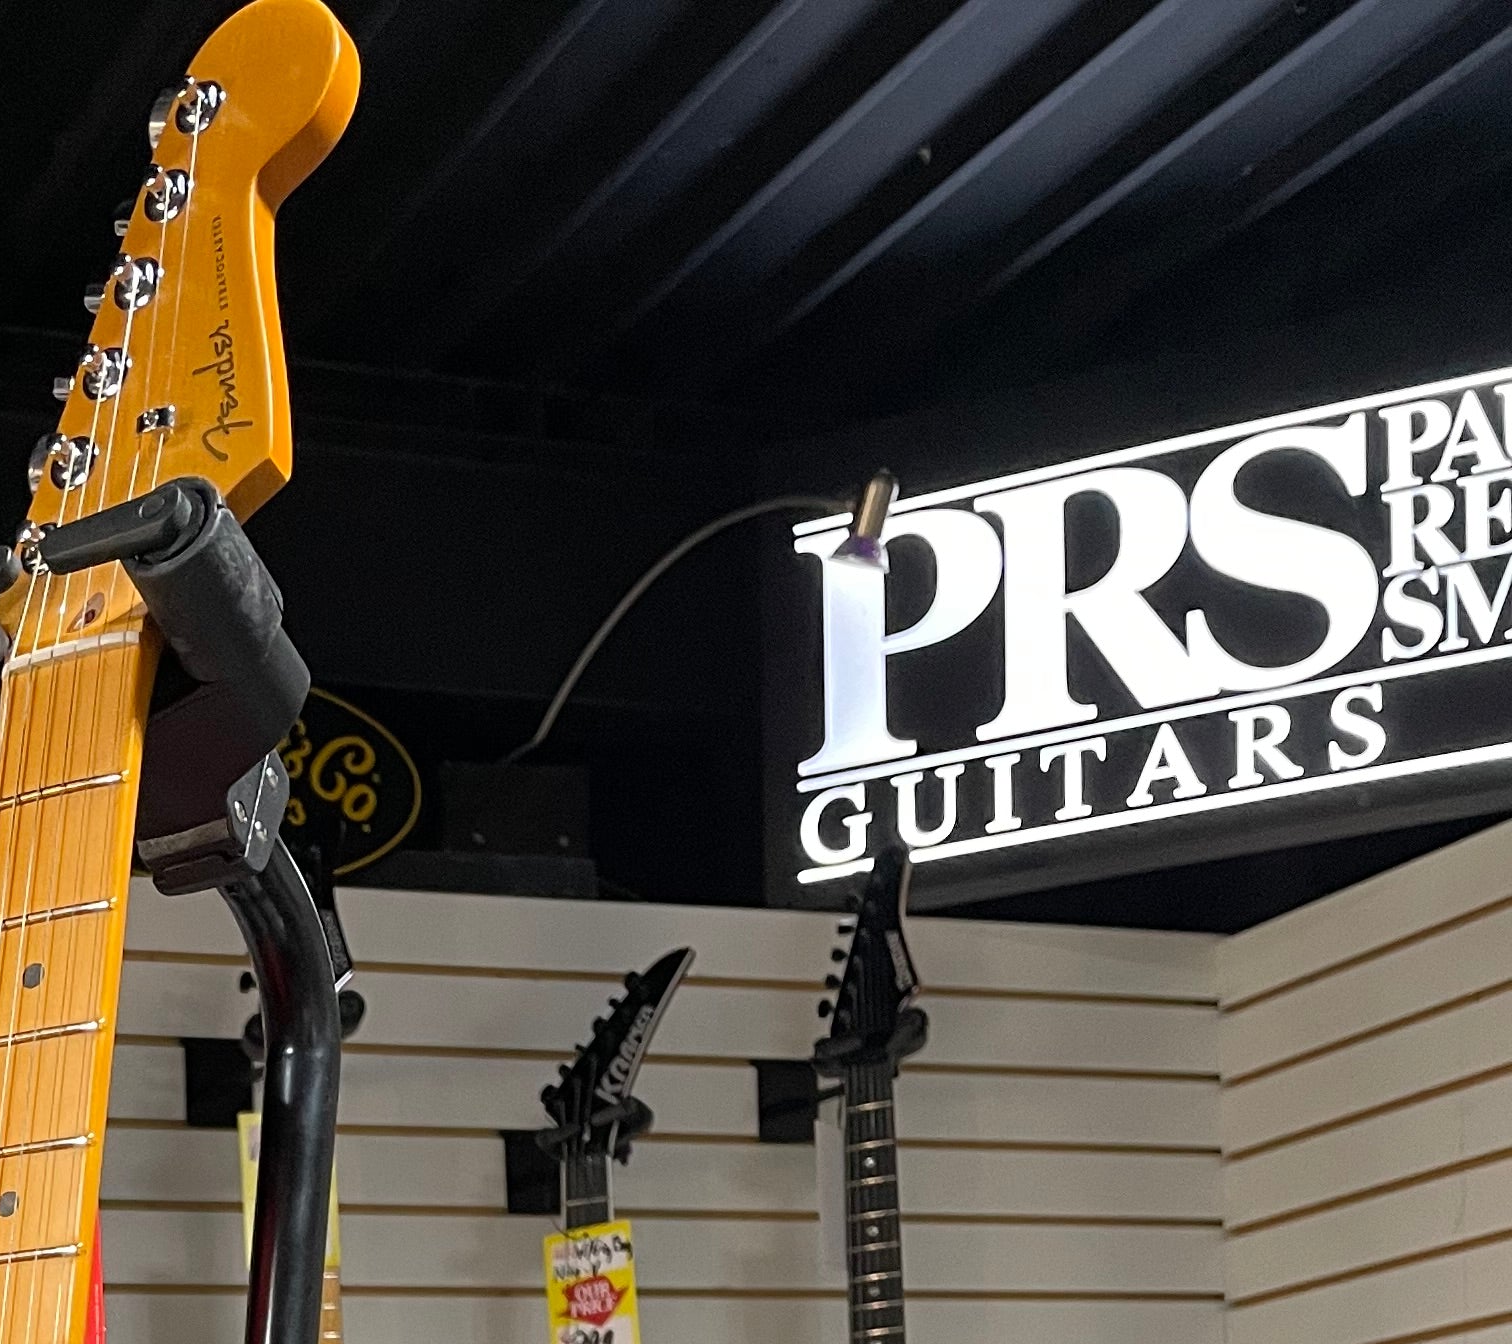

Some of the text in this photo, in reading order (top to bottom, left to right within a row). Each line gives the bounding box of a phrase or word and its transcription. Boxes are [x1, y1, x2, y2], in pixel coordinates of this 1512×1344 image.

[193, 320, 254, 462] Fender
[1378, 385, 1512, 494] PA
[794, 412, 1379, 777] PRS
[797, 683, 1388, 866] GUITARS
[574, 1280, 610, 1301] OUR
